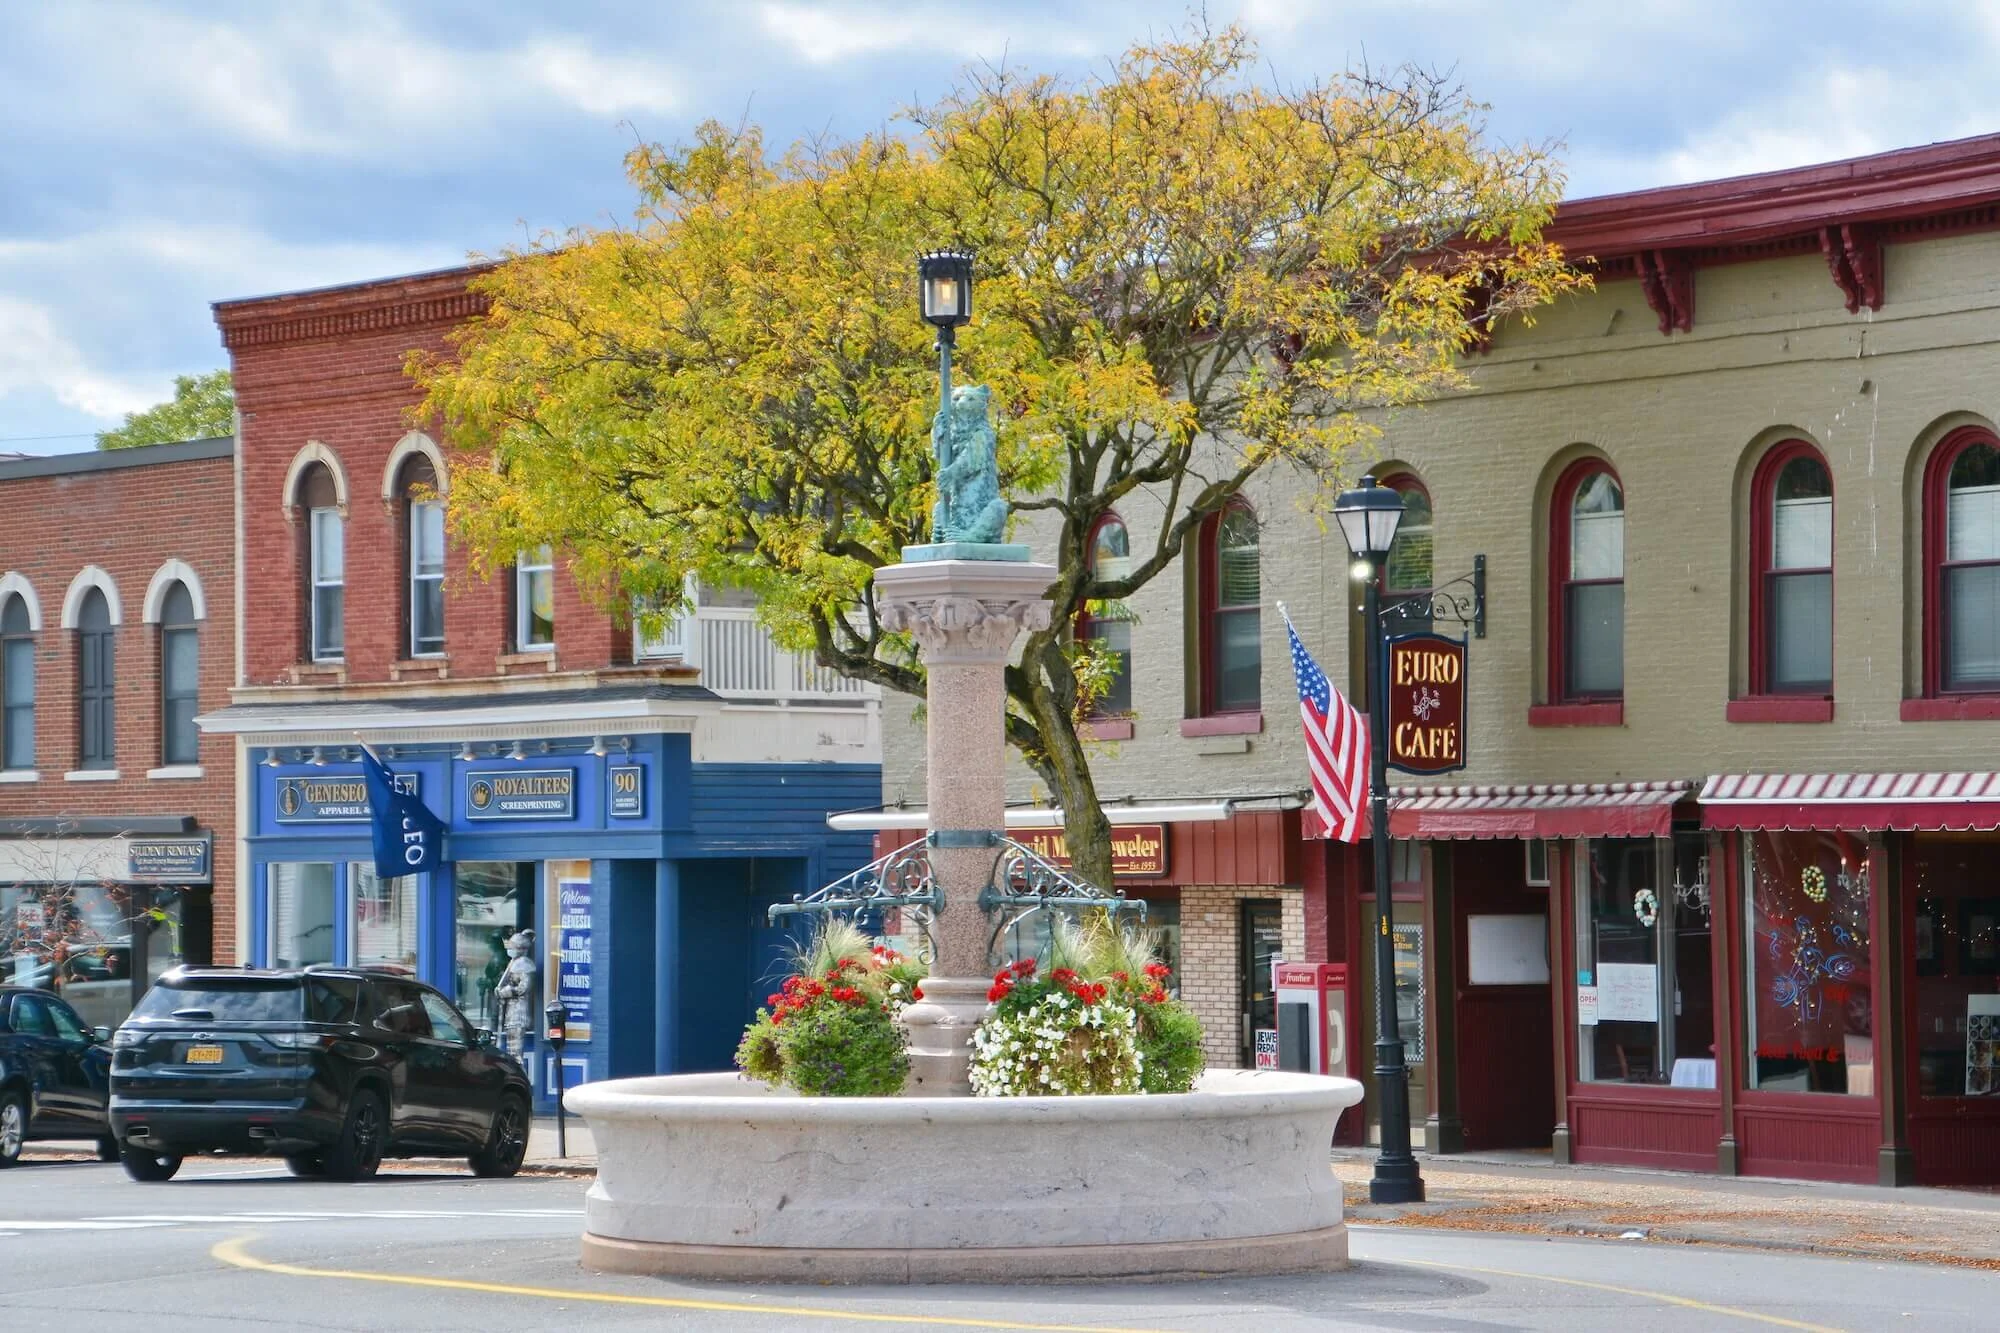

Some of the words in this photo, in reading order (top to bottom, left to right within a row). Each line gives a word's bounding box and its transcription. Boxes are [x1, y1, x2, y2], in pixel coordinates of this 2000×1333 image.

[1396, 650, 1459, 686] EURO
[1395, 721, 1457, 759] CAFÉ
[493, 776, 569, 796] ROYALTEES
[615, 773, 635, 793] 90
[305, 783, 367, 803] GENESEO
[318, 807, 362, 815] APPAREL
[501, 800, 561, 810] SCREENPRINTING
[129, 845, 164, 856] STUDENT
[167, 845, 201, 856] RENTALS
[1111, 834, 1159, 858] eweler
[1141, 861, 1156, 870] 1953
[561, 890, 591, 905] Welcom
[569, 936, 583, 949] NEW
[561, 950, 591, 963] STUDENTS
[563, 975, 590, 988] PARENTS
[1284, 972, 1311, 985] frontier
[1257, 1031, 1277, 1043] JEWE
[1257, 1043, 1276, 1053] REPA
[1257, 1053, 1271, 1067] ON
